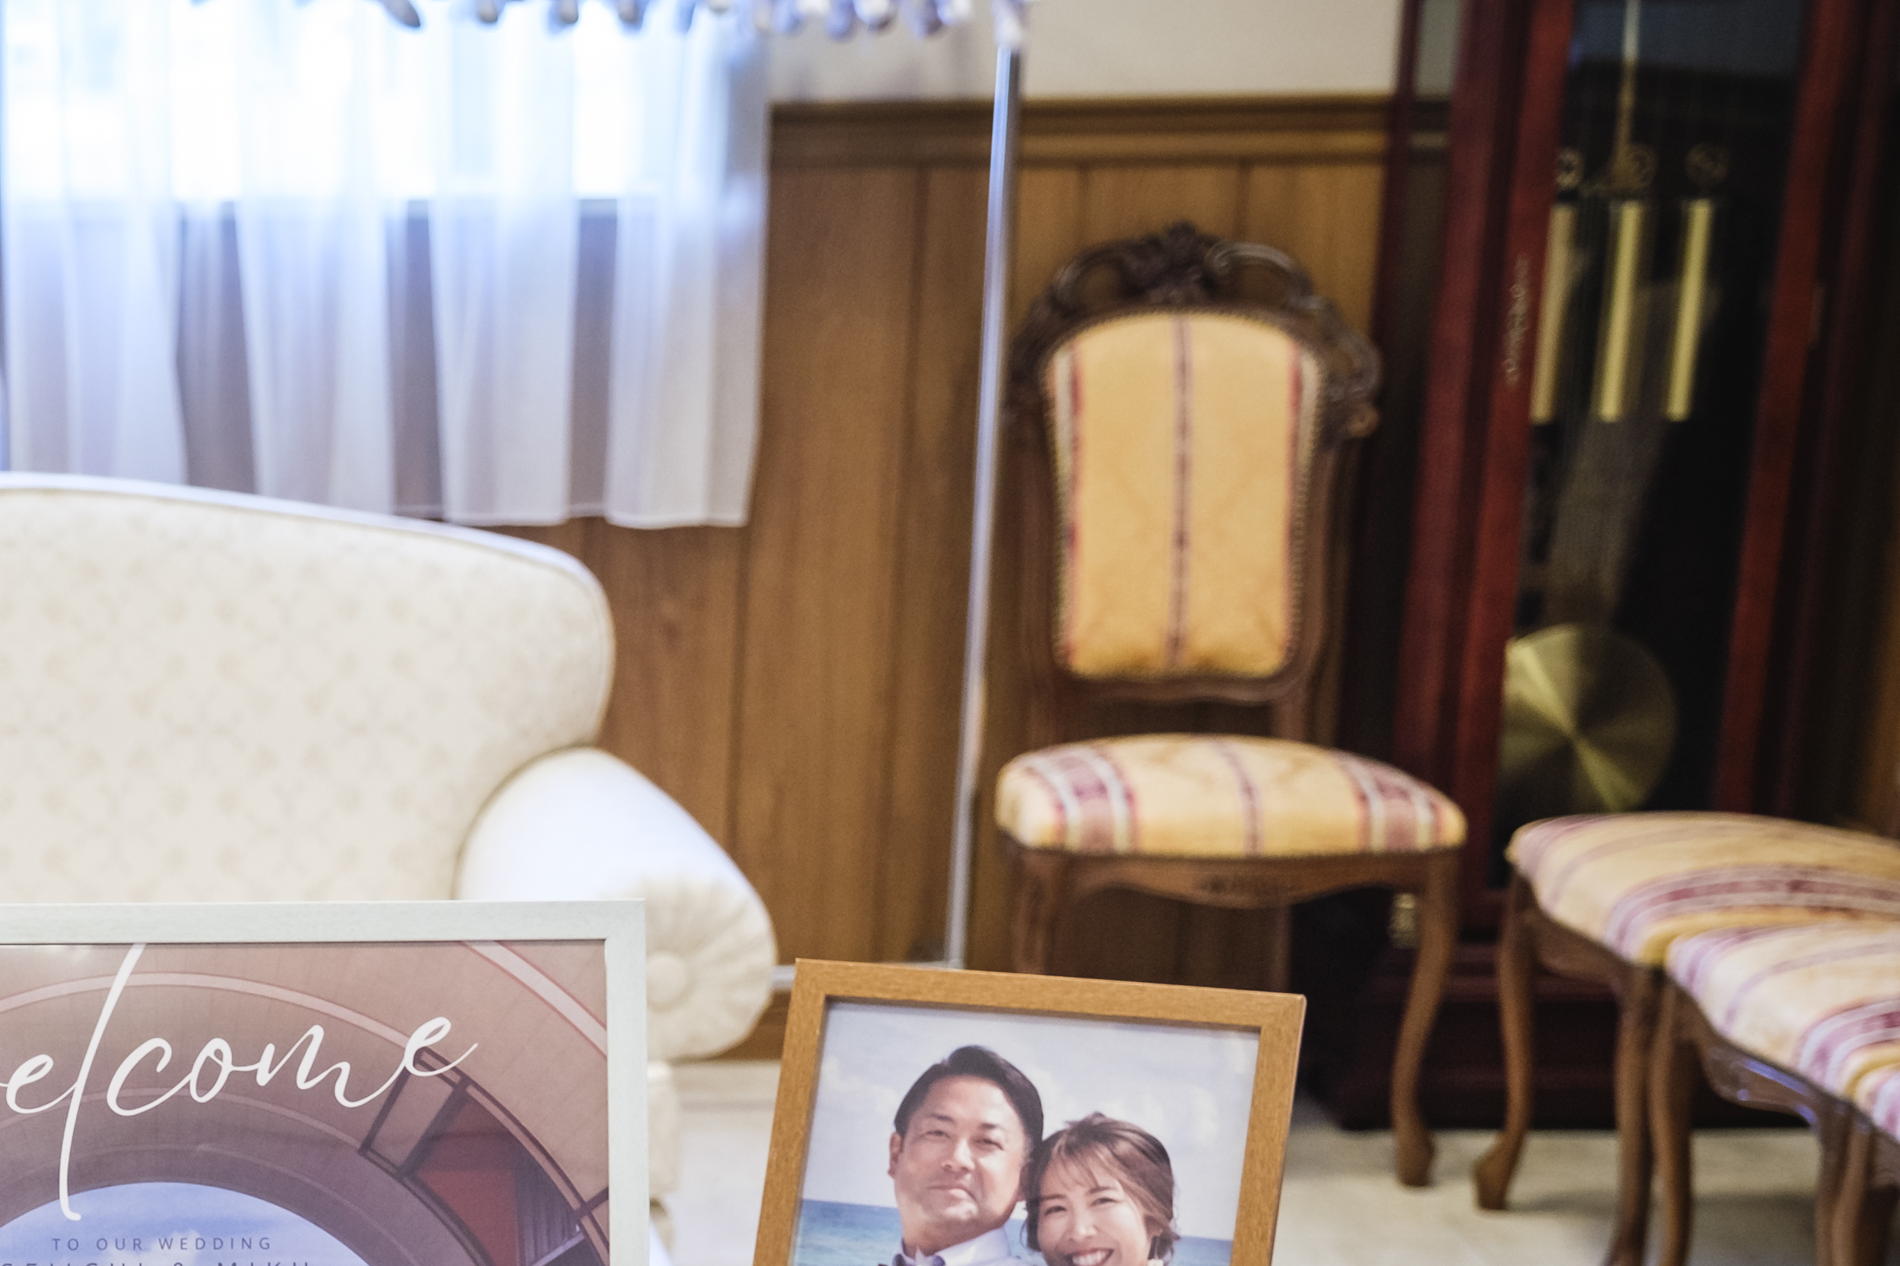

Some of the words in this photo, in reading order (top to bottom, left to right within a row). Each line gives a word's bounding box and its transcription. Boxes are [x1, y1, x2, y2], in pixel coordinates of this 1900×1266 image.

[52, 1238, 79, 1251] TO
[96, 1238, 143, 1250] OUR
[158, 1237, 271, 1250] WEDDING
